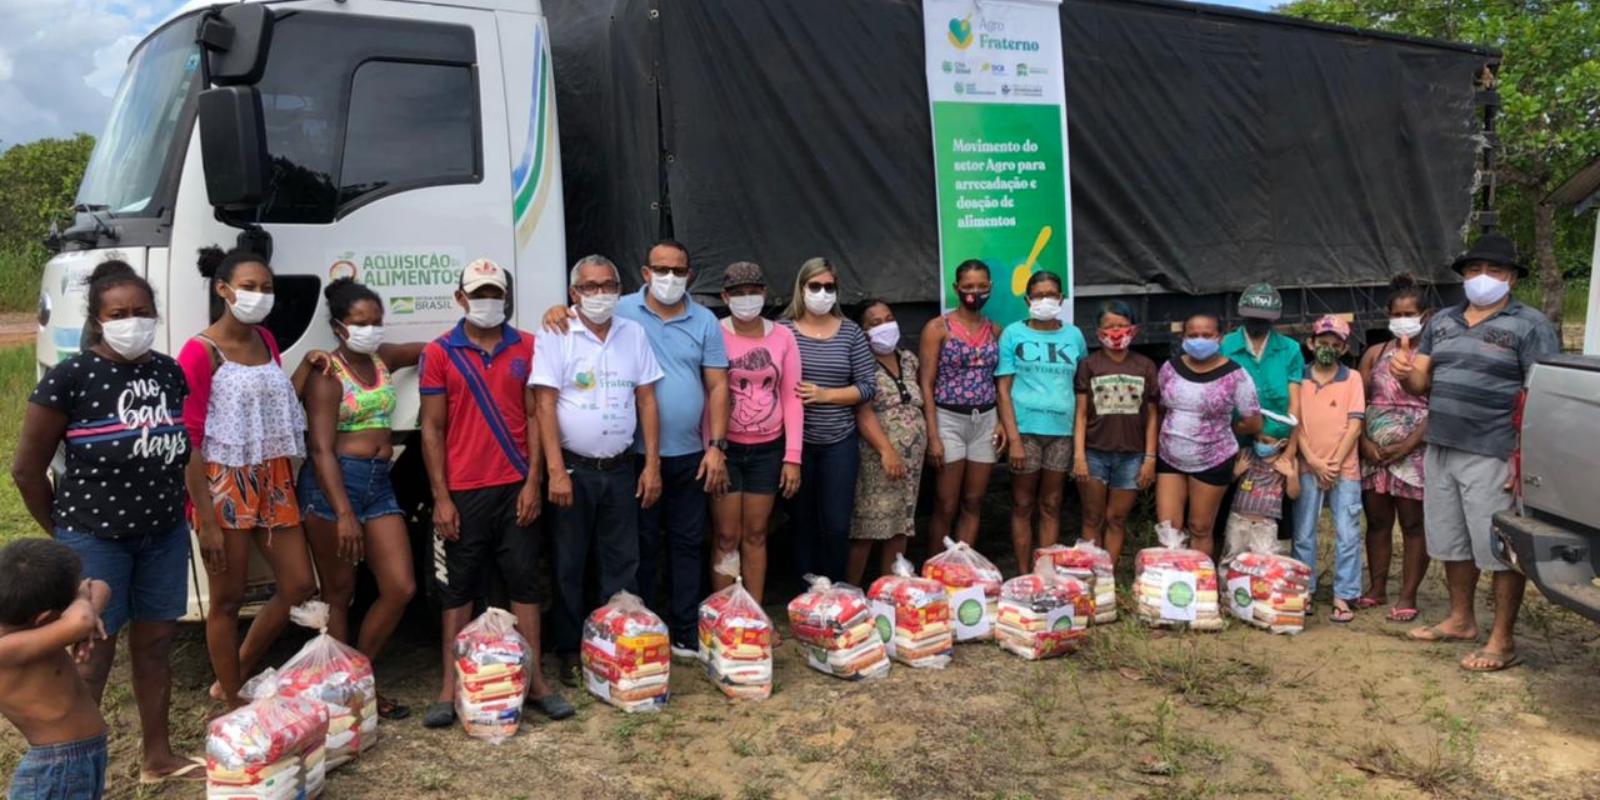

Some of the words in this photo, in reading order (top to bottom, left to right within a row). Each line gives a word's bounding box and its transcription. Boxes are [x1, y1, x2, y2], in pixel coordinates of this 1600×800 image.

[979, 18, 1005, 32] Agro
[979, 34, 1040, 51] Fraterno
[953, 139, 1021, 153] Movimento
[1022, 139, 1039, 152] do
[954, 160, 985, 172] setor
[986, 158, 1016, 174] Agro
[1018, 160, 1046, 174] para
[955, 178, 1028, 193] arrecadação
[1030, 180, 1038, 189] e
[956, 196, 999, 212] doação
[1000, 196, 1015, 208] de
[957, 215, 1016, 228] alimentos
[364, 270, 461, 286] ALIMENTOS
[415, 300, 452, 311] BRASIL
[1015, 341, 1074, 366] CK
[132, 378, 160, 398] no
[118, 389, 174, 430] bad
[133, 426, 186, 464] days
[433, 528, 449, 586] NIK
